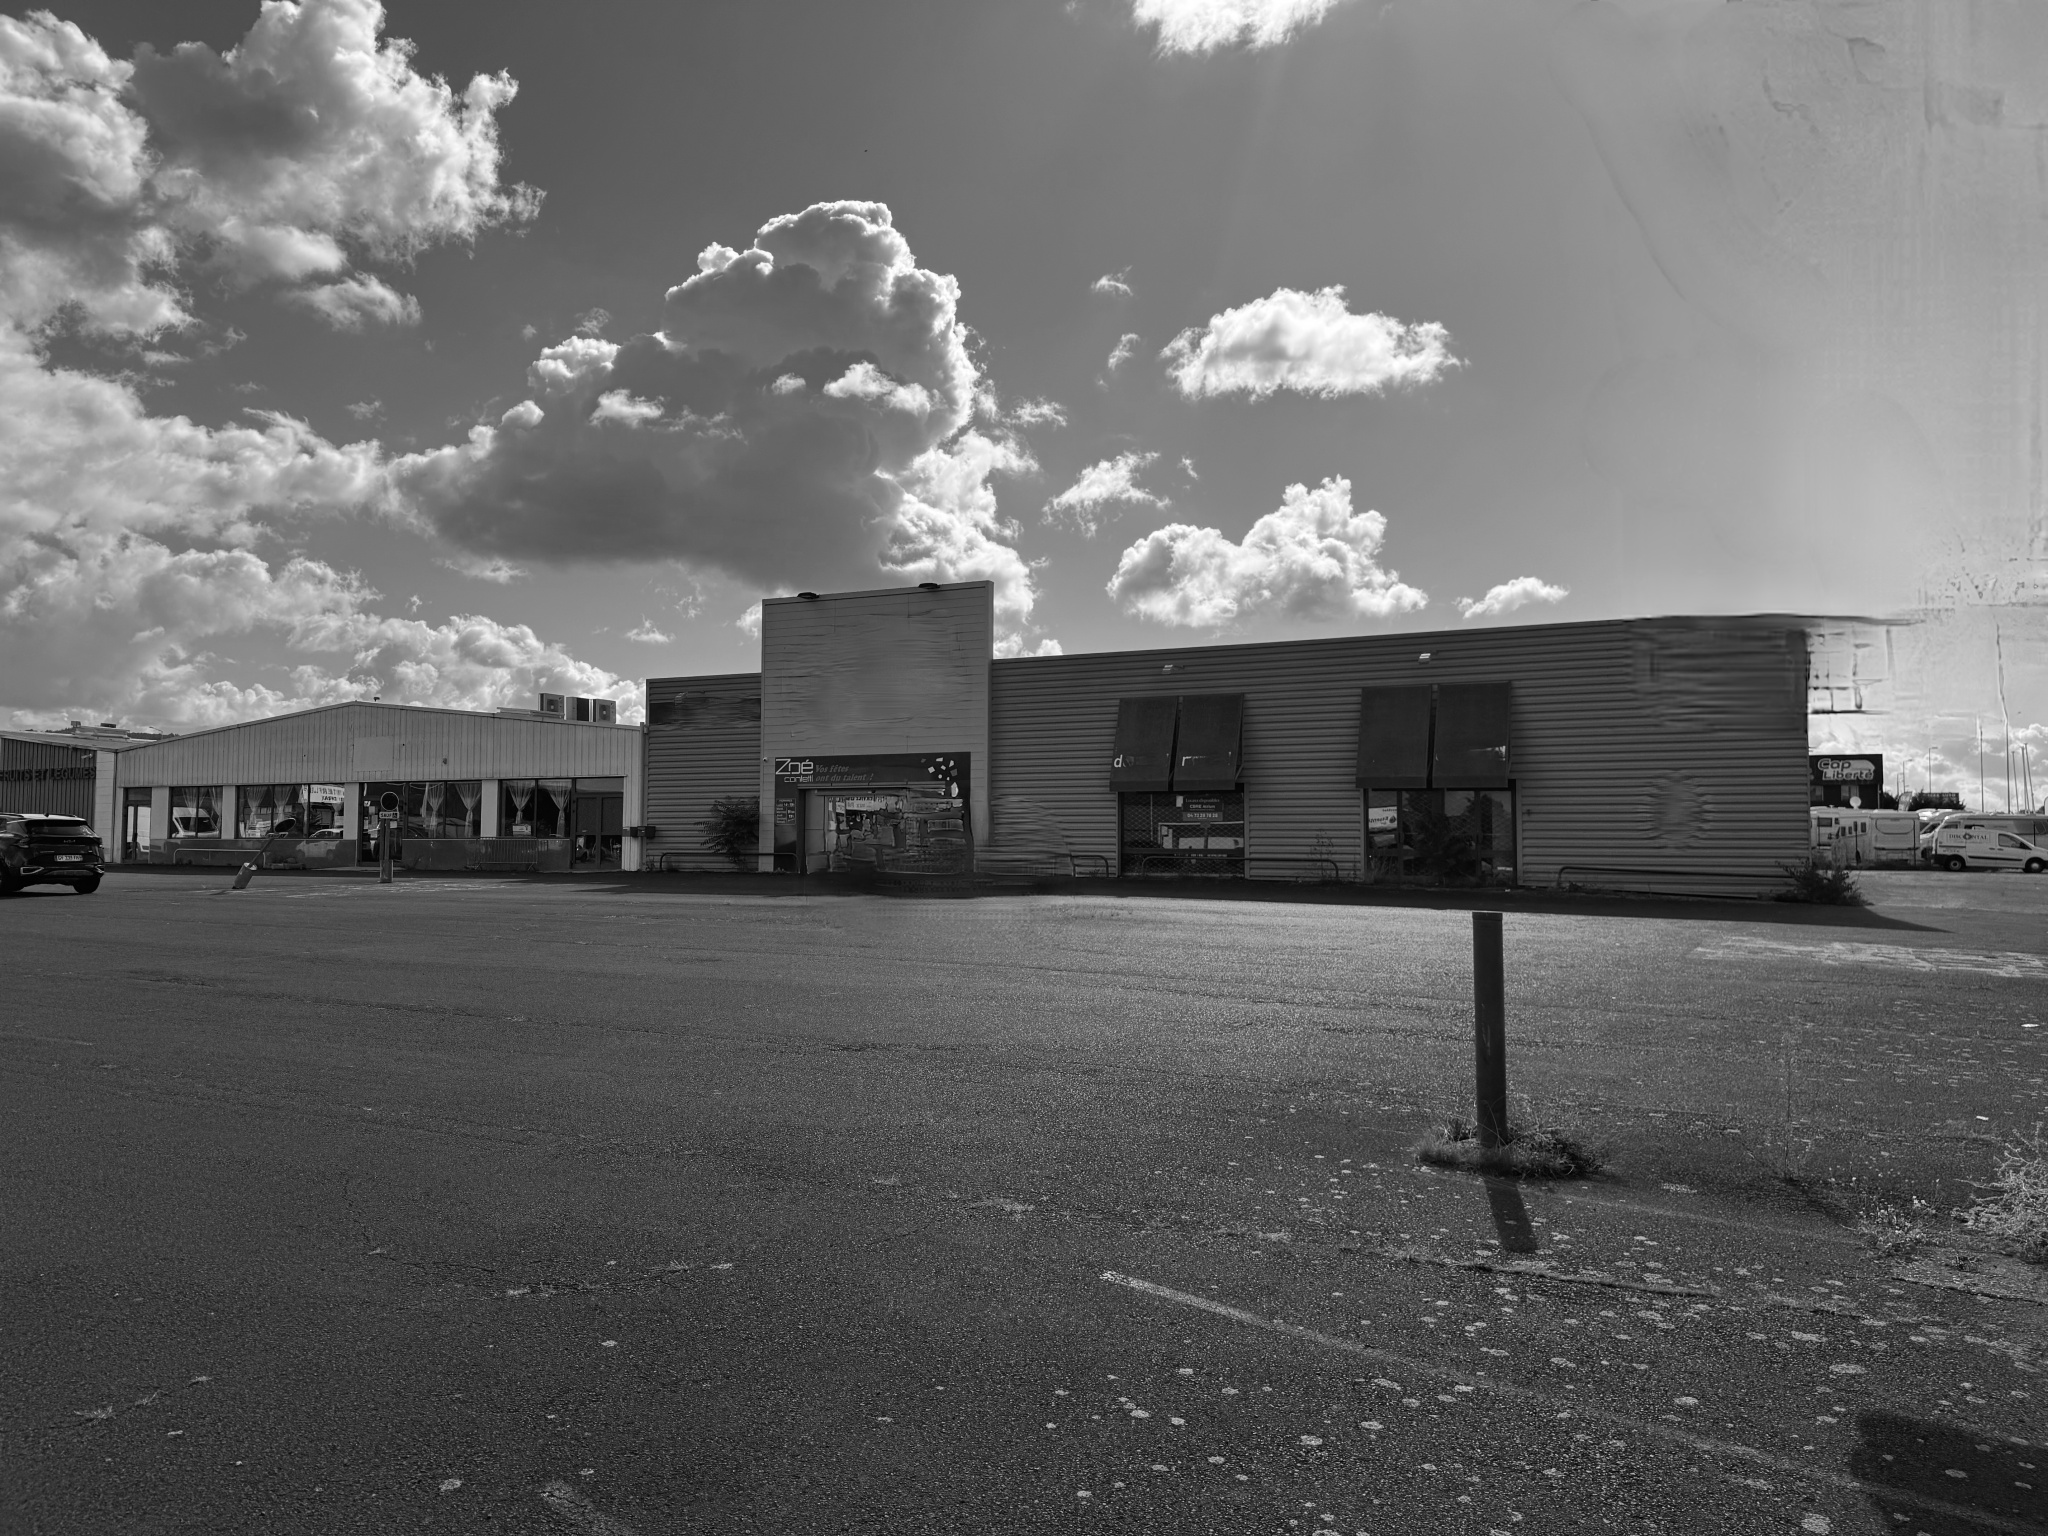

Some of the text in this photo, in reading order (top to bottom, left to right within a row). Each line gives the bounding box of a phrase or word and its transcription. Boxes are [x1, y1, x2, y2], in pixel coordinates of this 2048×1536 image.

[775, 758, 814, 775] Zoé
[815, 764, 849, 773] Vos fêtes
[1818, 758, 1851, 772] Cap
[0, 769, 33, 781] FRUITS
[34, 768, 48, 781] ET
[784, 775, 814, 783] confetti
[815, 774, 828, 782] ont
[831, 773, 841, 782] du
[843, 773, 867, 782] talent
[1822, 769, 1874, 781] Liberté
